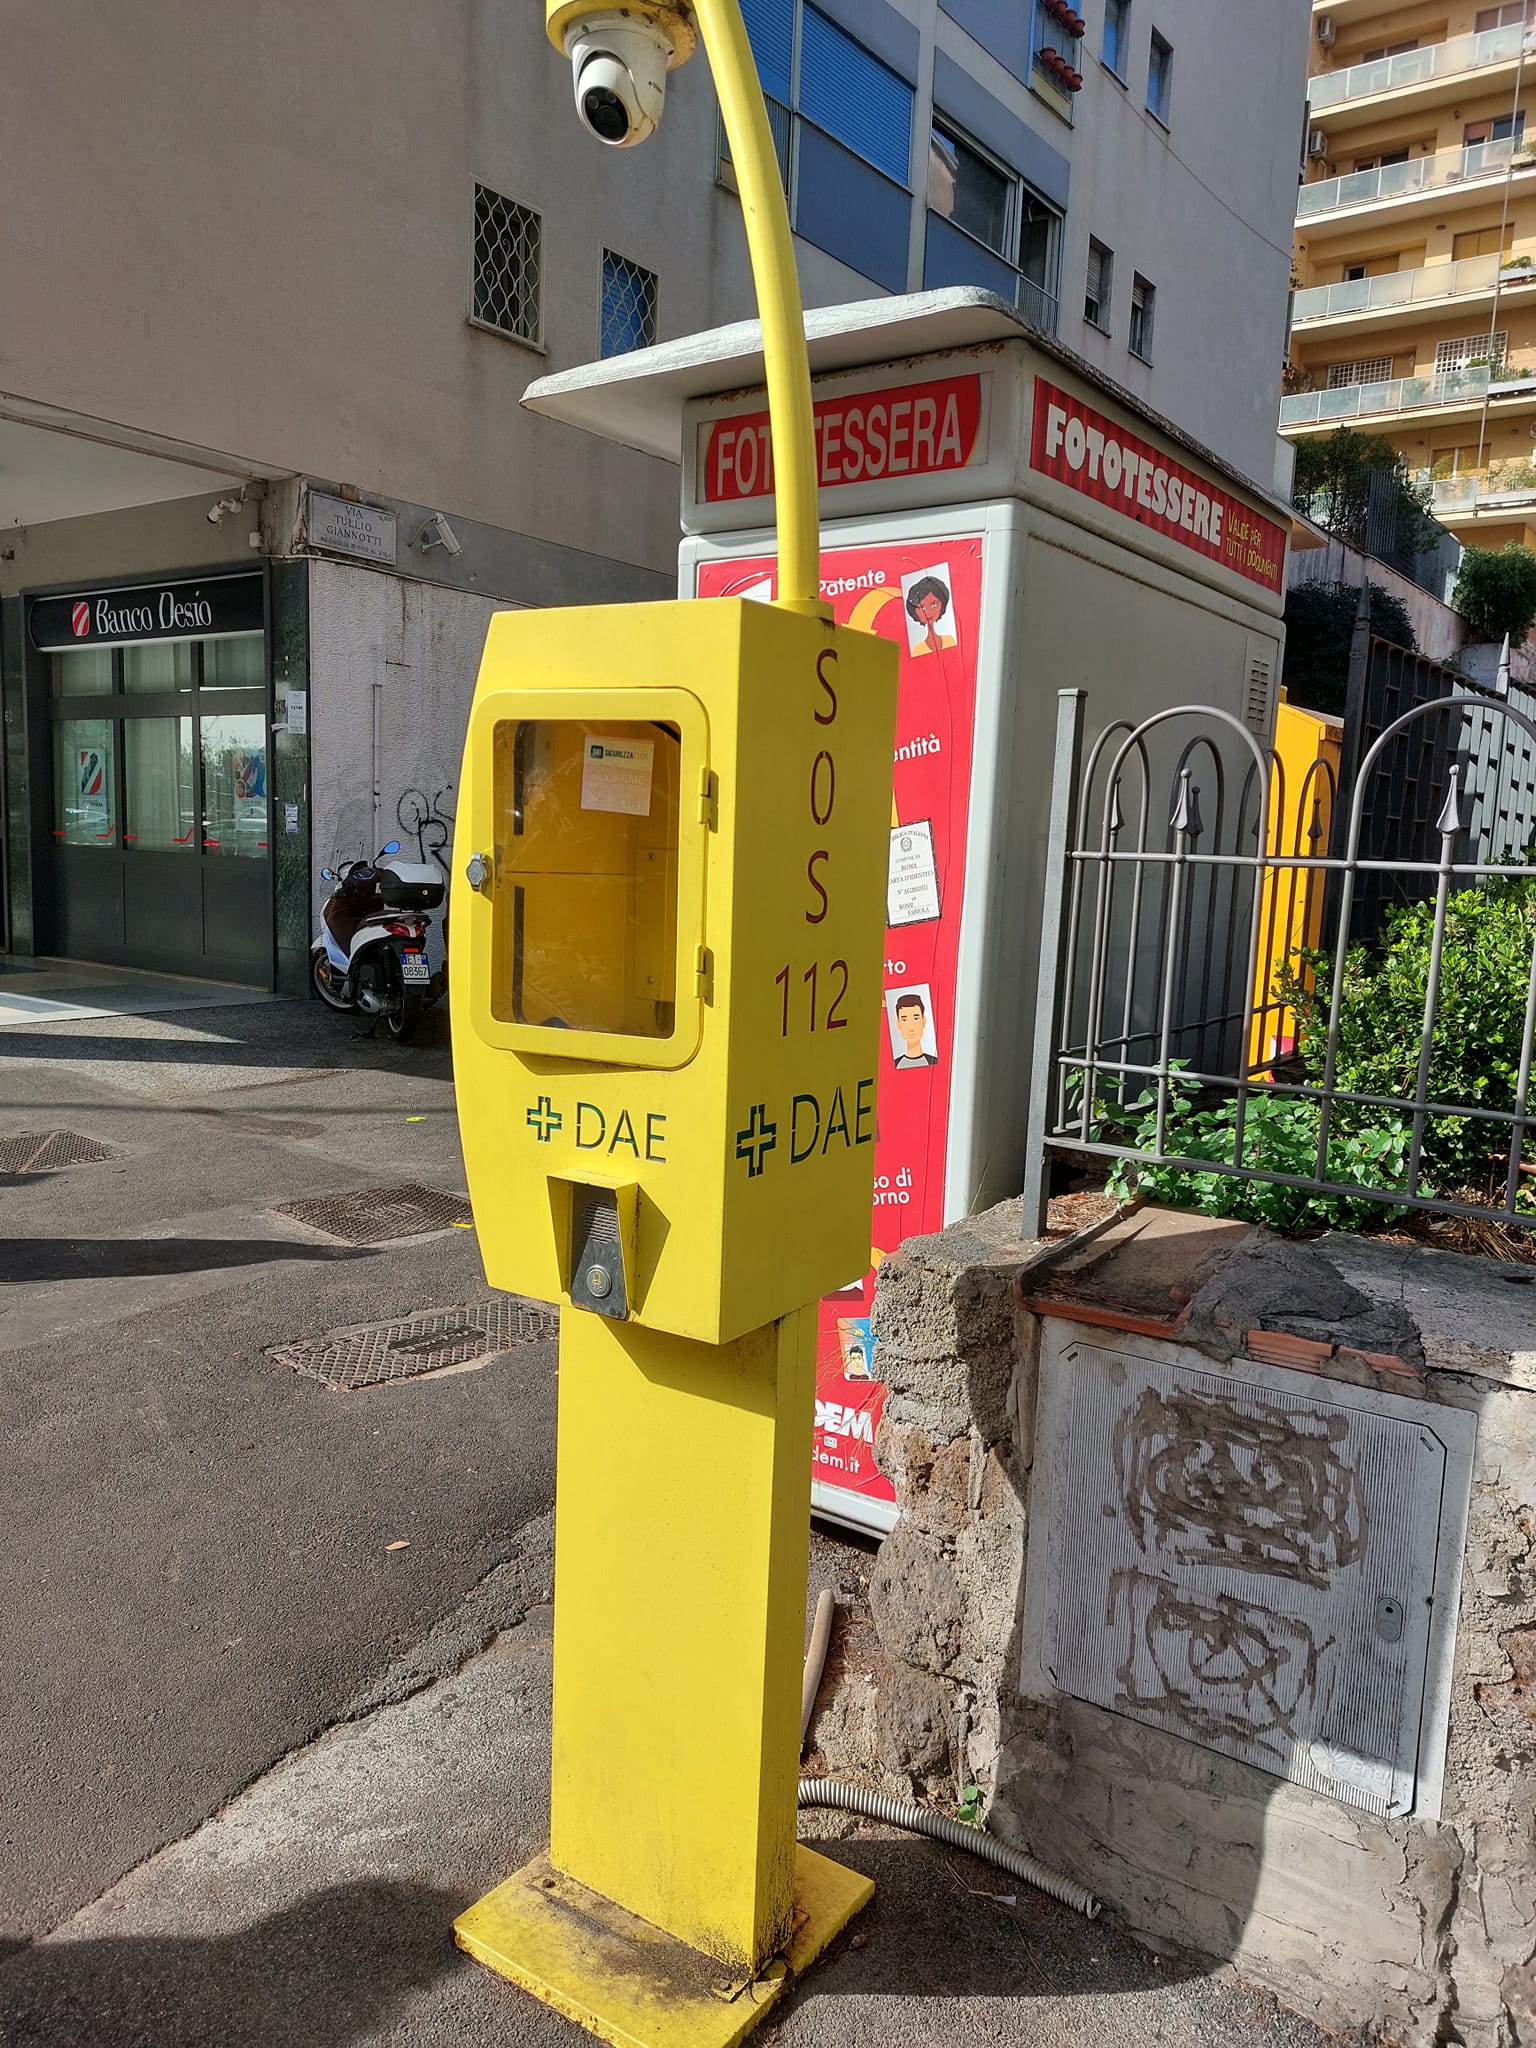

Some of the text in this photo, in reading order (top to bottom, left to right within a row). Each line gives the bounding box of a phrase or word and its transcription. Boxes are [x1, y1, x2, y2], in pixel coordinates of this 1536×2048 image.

[717, 393, 962, 496] FOTESSERA
[1046, 403, 1224, 547] FOTOTESSERE
[335, 514, 372, 532] TULLIO
[345, 506, 363, 519] VIA
[1228, 508, 1261, 550] VALIDE PER
[326, 525, 381, 546] GIANNOTTI
[1226, 537, 1243, 562] TUTTI
[1247, 550, 1278, 582] DOCUMENTI
[96, 590, 212, 635] Banco Desio
[901, 863, 918, 871] ROMA
[775, 960, 849, 1037] 112
[576, 1101, 667, 1163] DAE
[790, 1078, 874, 1165] DAE
[896, 1166, 912, 1187] di
[1351, 1758, 1390, 1785] Enel
